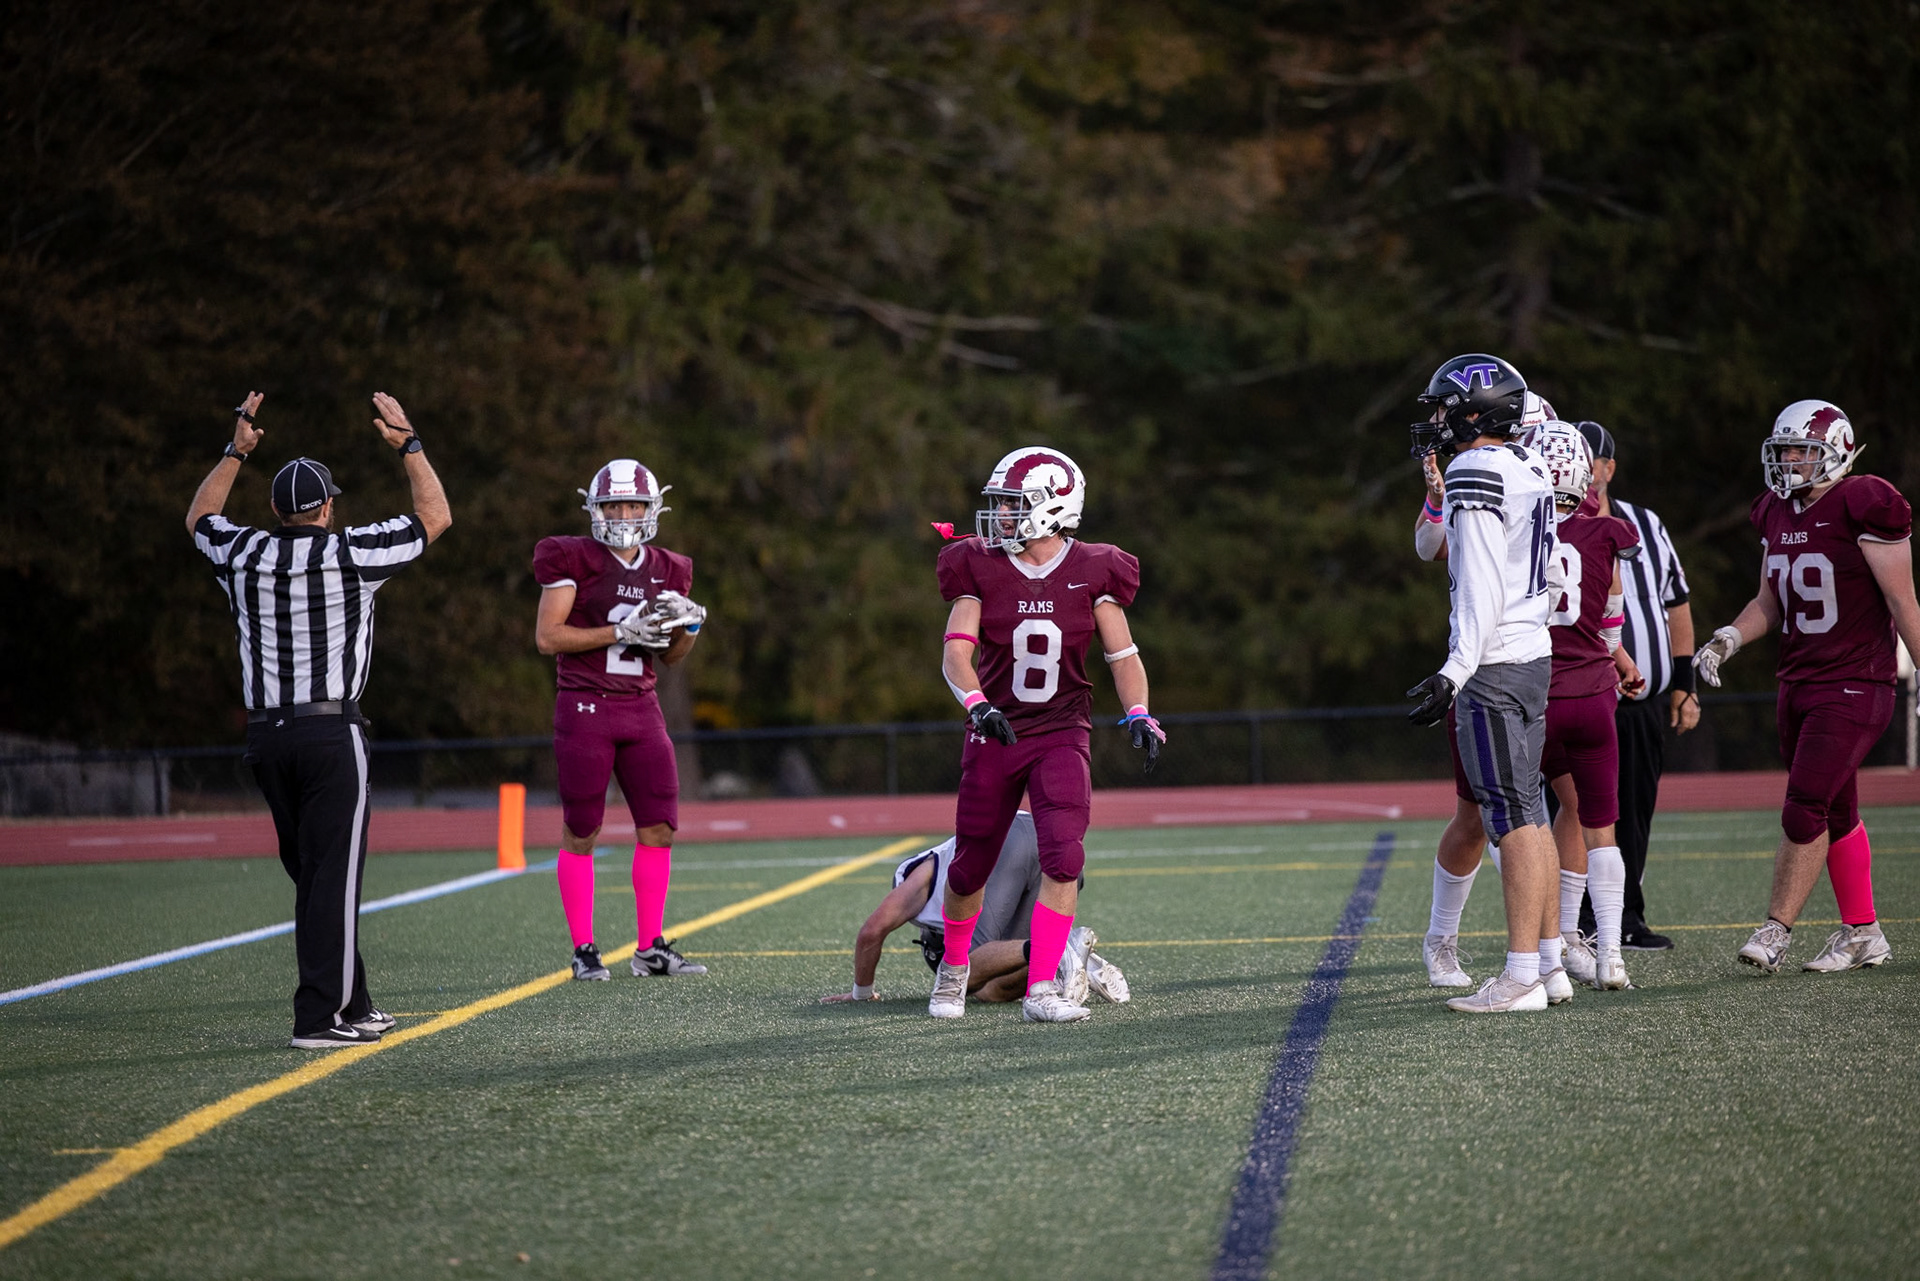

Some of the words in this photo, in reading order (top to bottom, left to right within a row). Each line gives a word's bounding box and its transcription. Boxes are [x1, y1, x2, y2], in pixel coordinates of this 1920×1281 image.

[1447, 363, 1498, 392] VT
[1781, 532, 1809, 545] RAMS
[616, 584, 645, 599] RAMS
[1767, 552, 1839, 634] 79
[1018, 601, 1054, 613] RAMS
[606, 603, 644, 676] 2
[1012, 619, 1062, 703] 8
